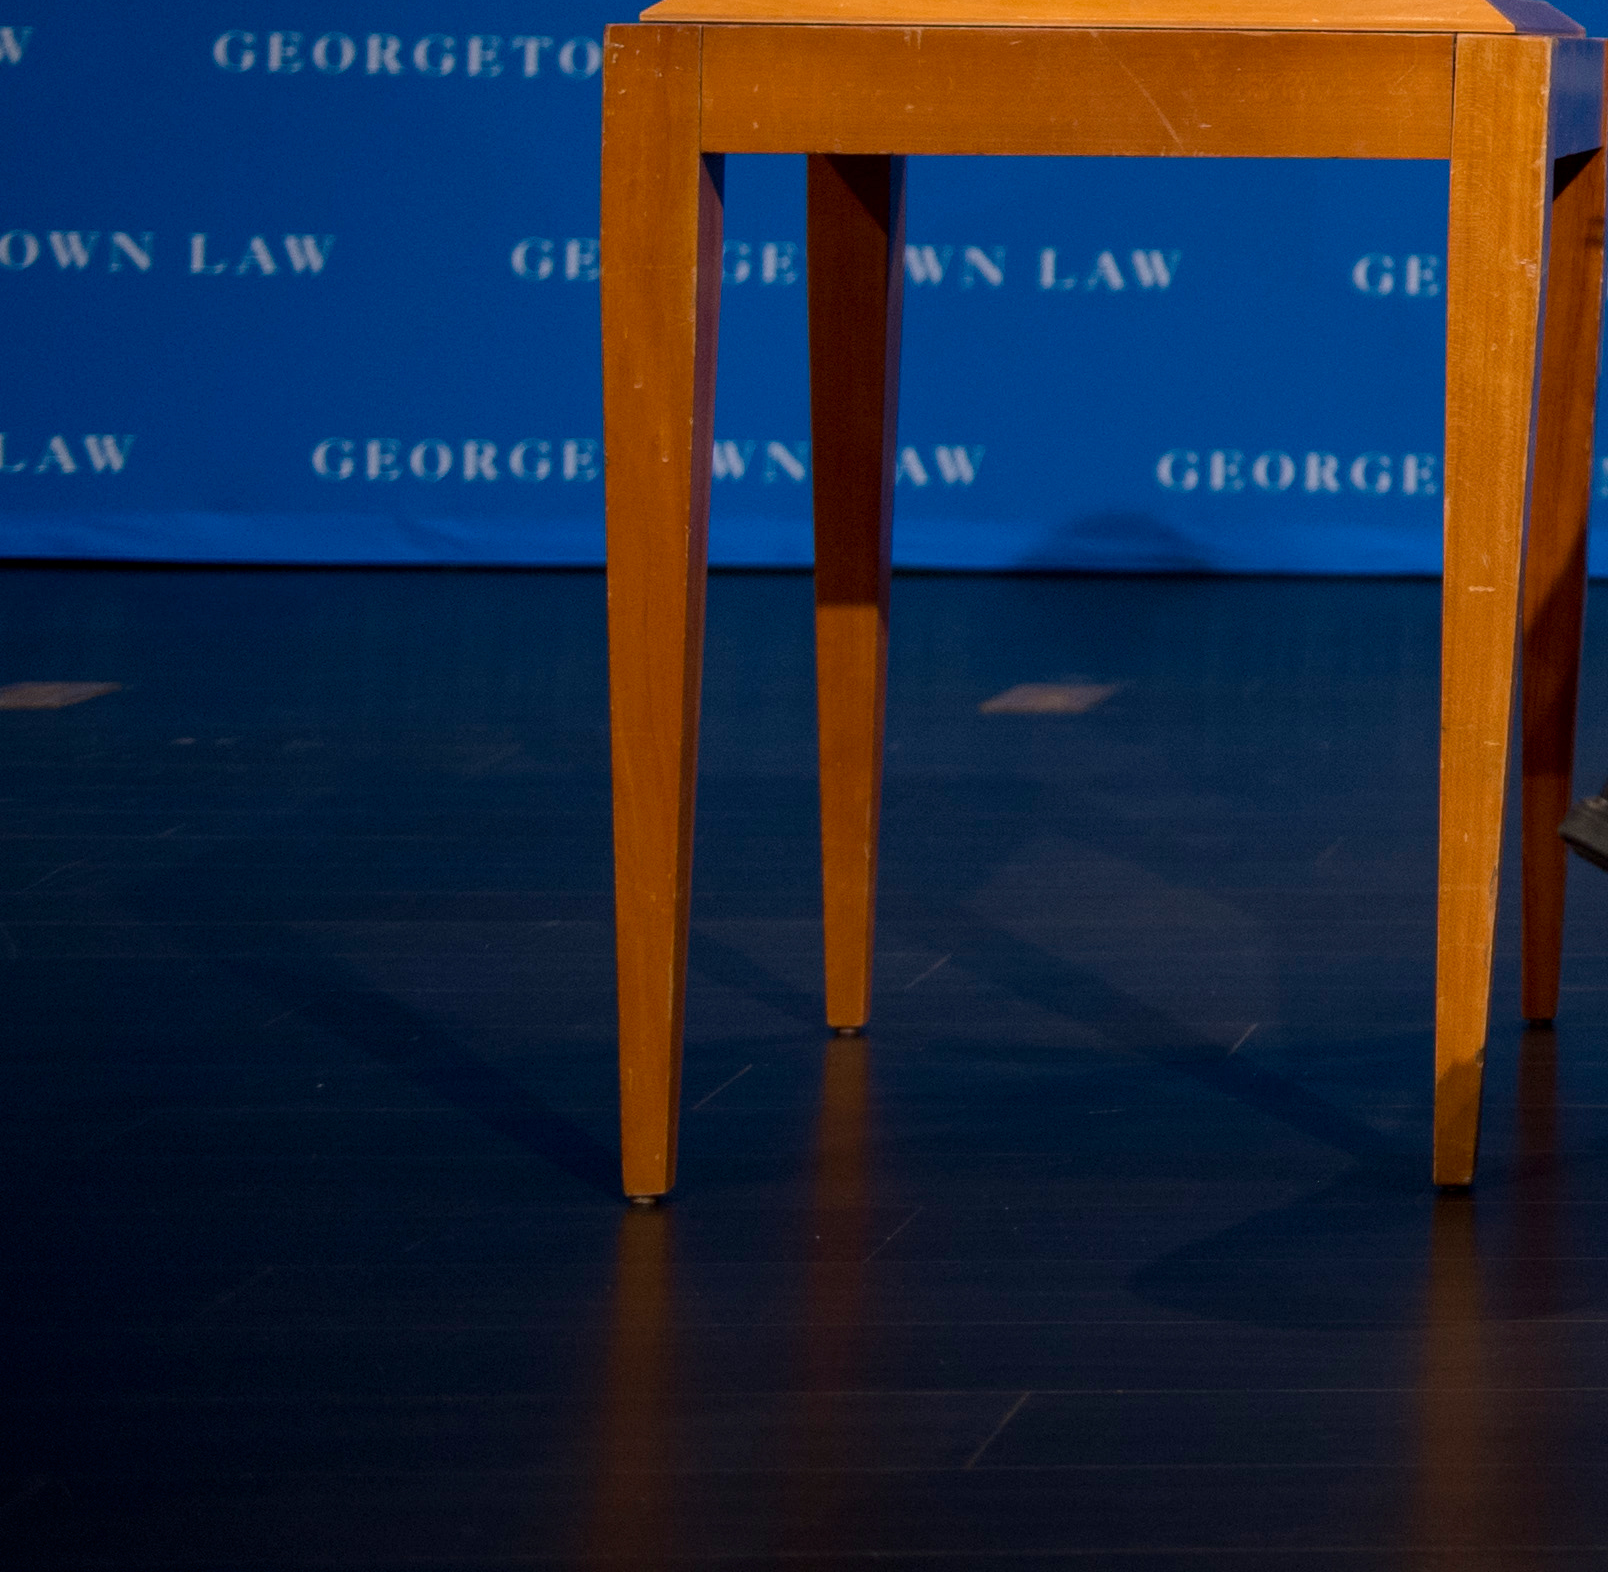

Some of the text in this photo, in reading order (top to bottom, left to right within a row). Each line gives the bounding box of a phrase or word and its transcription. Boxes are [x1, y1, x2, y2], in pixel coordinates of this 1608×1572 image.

[213, 32, 601, 78] GEORGETO
[190, 233, 332, 275] LAW
[1039, 248, 1179, 290] LAW
[896, 446, 983, 486] AW
